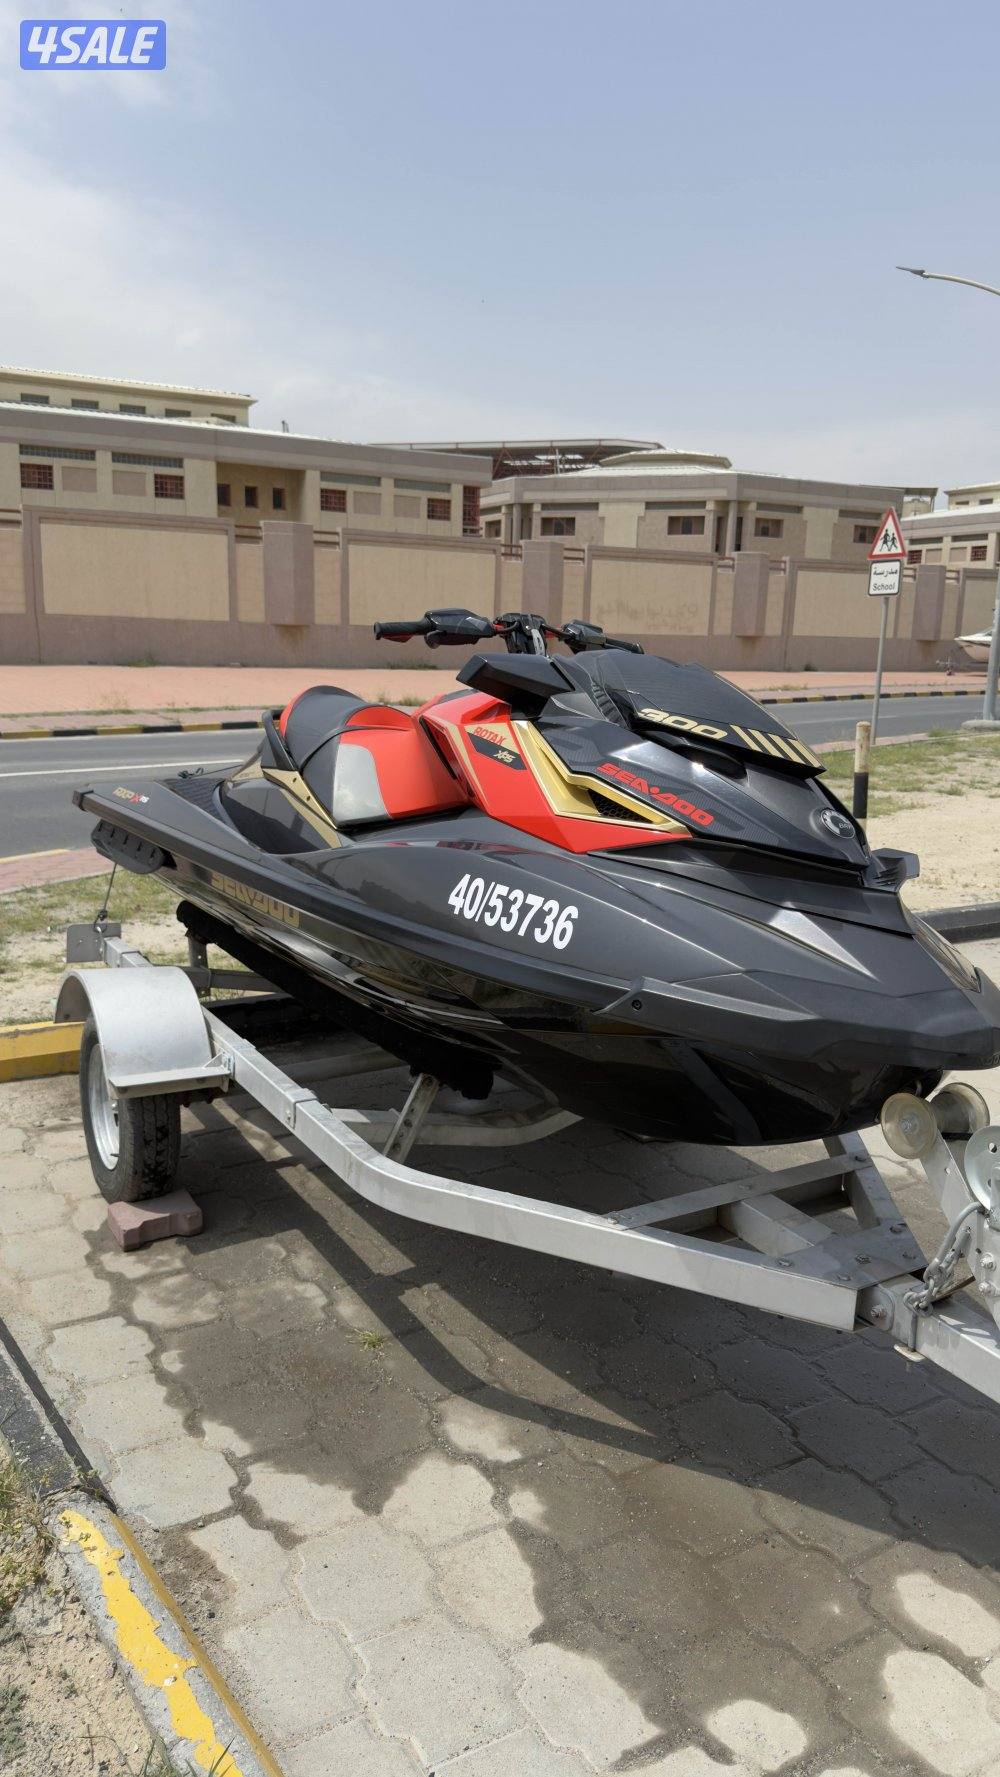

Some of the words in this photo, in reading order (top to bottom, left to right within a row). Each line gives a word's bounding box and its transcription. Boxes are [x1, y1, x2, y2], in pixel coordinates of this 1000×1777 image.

[872, 566, 898, 578] مدرسة
[872, 582, 896, 592] School
[637, 707, 728, 740] 300
[473, 726, 507, 746] ROTAX
[447, 873, 579, 950] 40/53736
